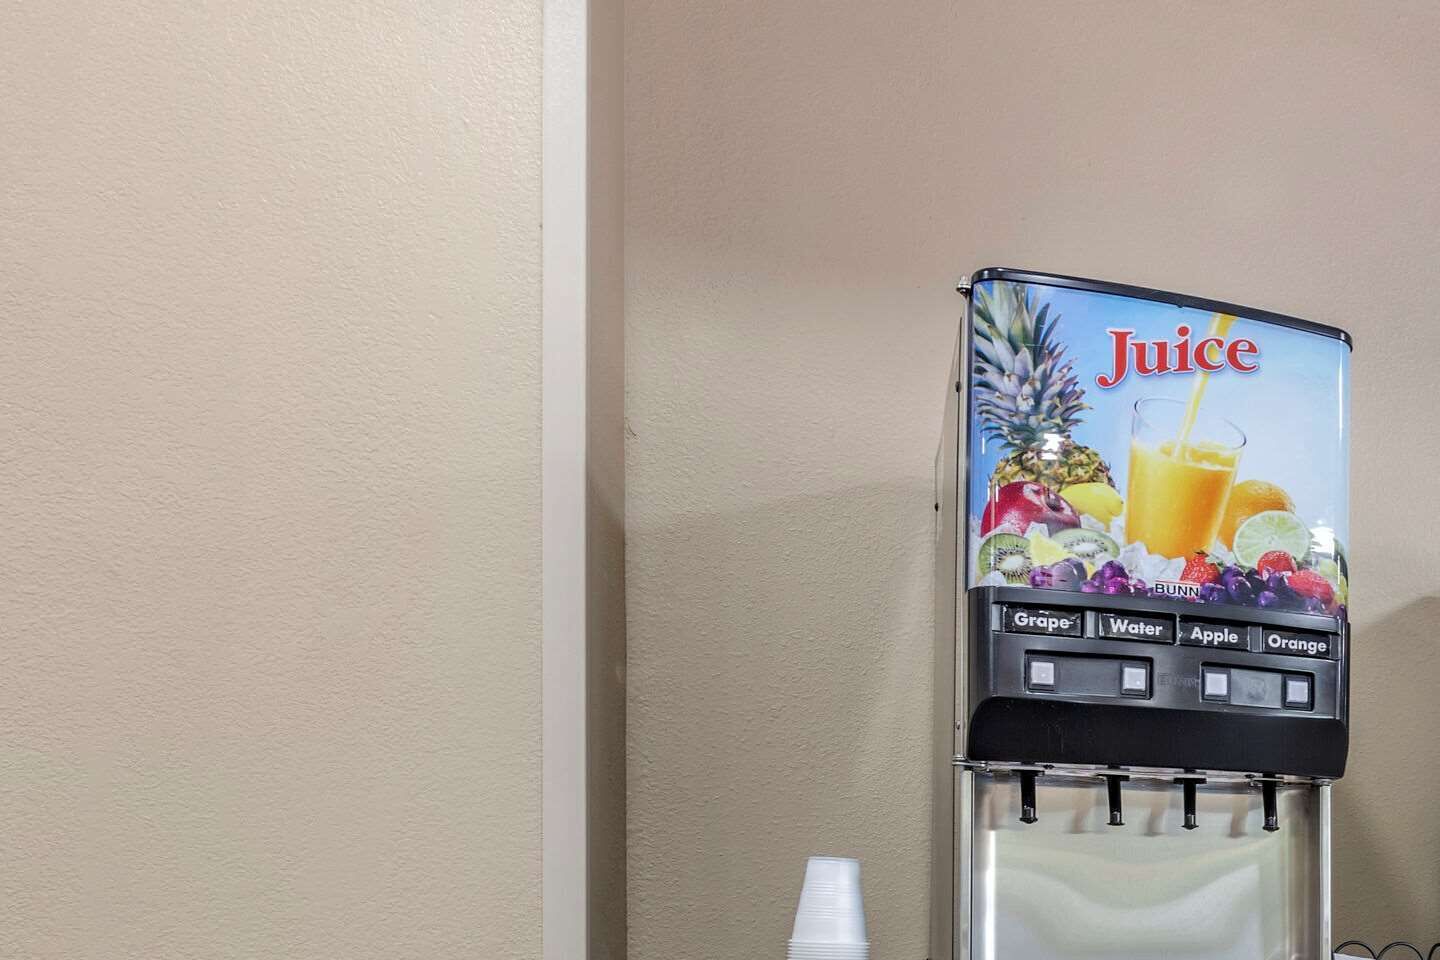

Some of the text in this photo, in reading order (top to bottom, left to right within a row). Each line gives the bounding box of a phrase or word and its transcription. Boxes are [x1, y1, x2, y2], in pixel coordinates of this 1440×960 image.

[1095, 325, 1260, 390] Juice
[1155, 583, 1199, 596] BUNN
[1014, 612, 1071, 631] Grape
[1109, 618, 1163, 636] Water
[1190, 626, 1239, 645] Apple
[1268, 634, 1327, 654] Orange
